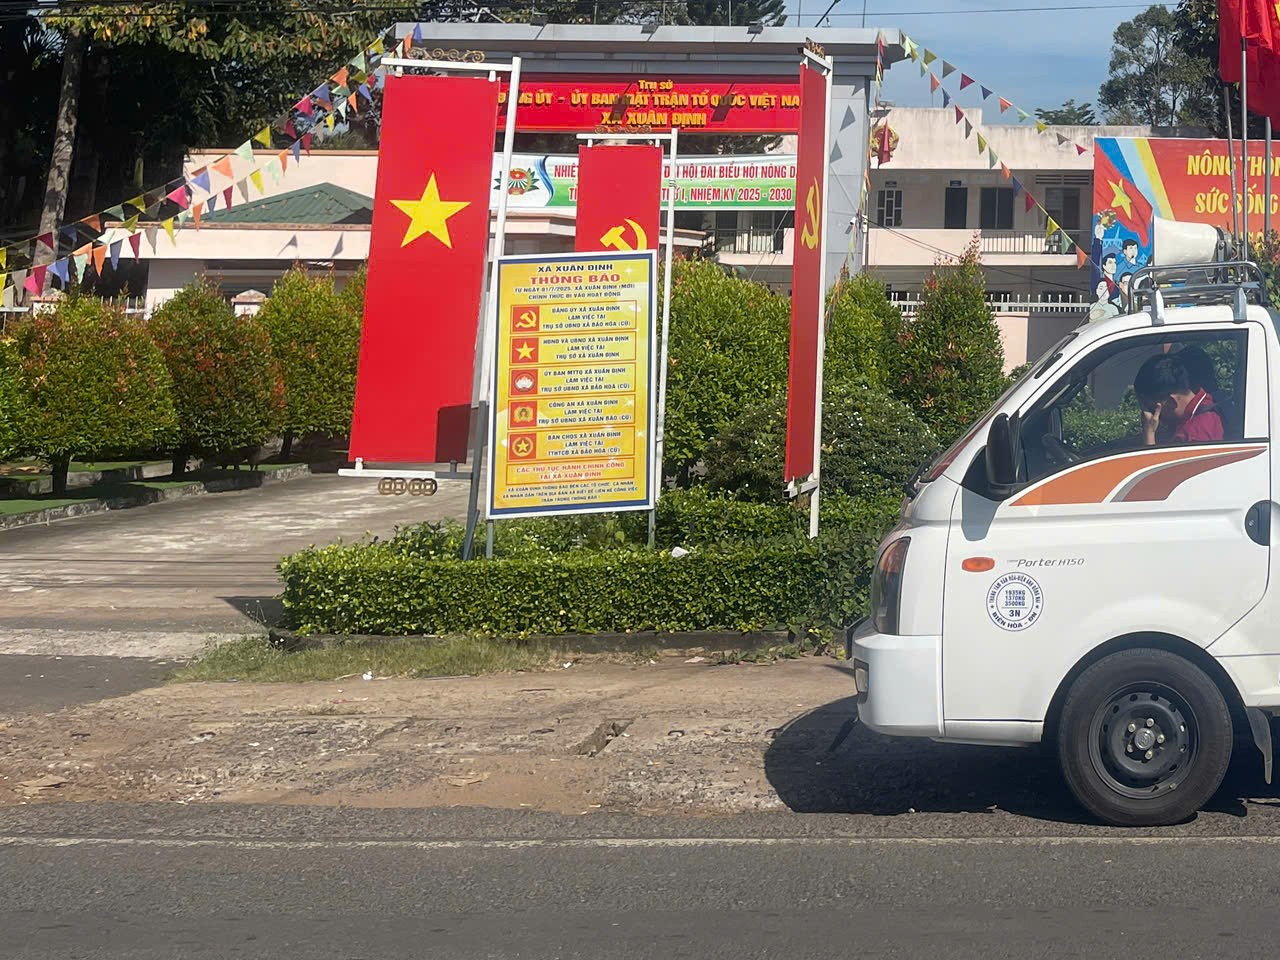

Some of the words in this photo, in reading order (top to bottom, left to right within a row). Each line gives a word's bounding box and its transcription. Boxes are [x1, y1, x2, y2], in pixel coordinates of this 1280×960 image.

[639, 80, 657, 92] Trụ
[660, 79, 673, 90] sở
[535, 89, 552, 105] ỦY
[571, 90, 587, 106] ỦY
[591, 93, 619, 106] BAN
[653, 92, 688, 108] TRẬN
[691, 89, 709, 107] TỔ
[711, 92, 747, 108] QUỐC
[750, 92, 778, 109] VIỆT
[781, 95, 800, 108] NA
[626, 110, 668, 126] XUÂN
[671, 112, 707, 128] ĐỊNH
[682, 163, 698, 181] HỘI
[700, 165, 716, 181] ĐẠI
[719, 161, 740, 178] BIỂU
[742, 163, 758, 181] HỘI
[761, 162, 787, 179] NÔNG
[690, 185, 721, 203] NHIỆM
[738, 188, 760, 201] 2025
[769, 188, 792, 201] 2030
[1195, 185, 1229, 214] SỨC
[555, 264, 584, 272] XUÂN
[588, 263, 613, 272] ĐỊNH
[530, 274, 583, 285] THÔNG
[588, 272, 621, 283] BÁO
[1017, 558, 1057, 568] Porter
[1058, 557, 1085, 566] H150
[1009, 609, 1021, 617] 3N
